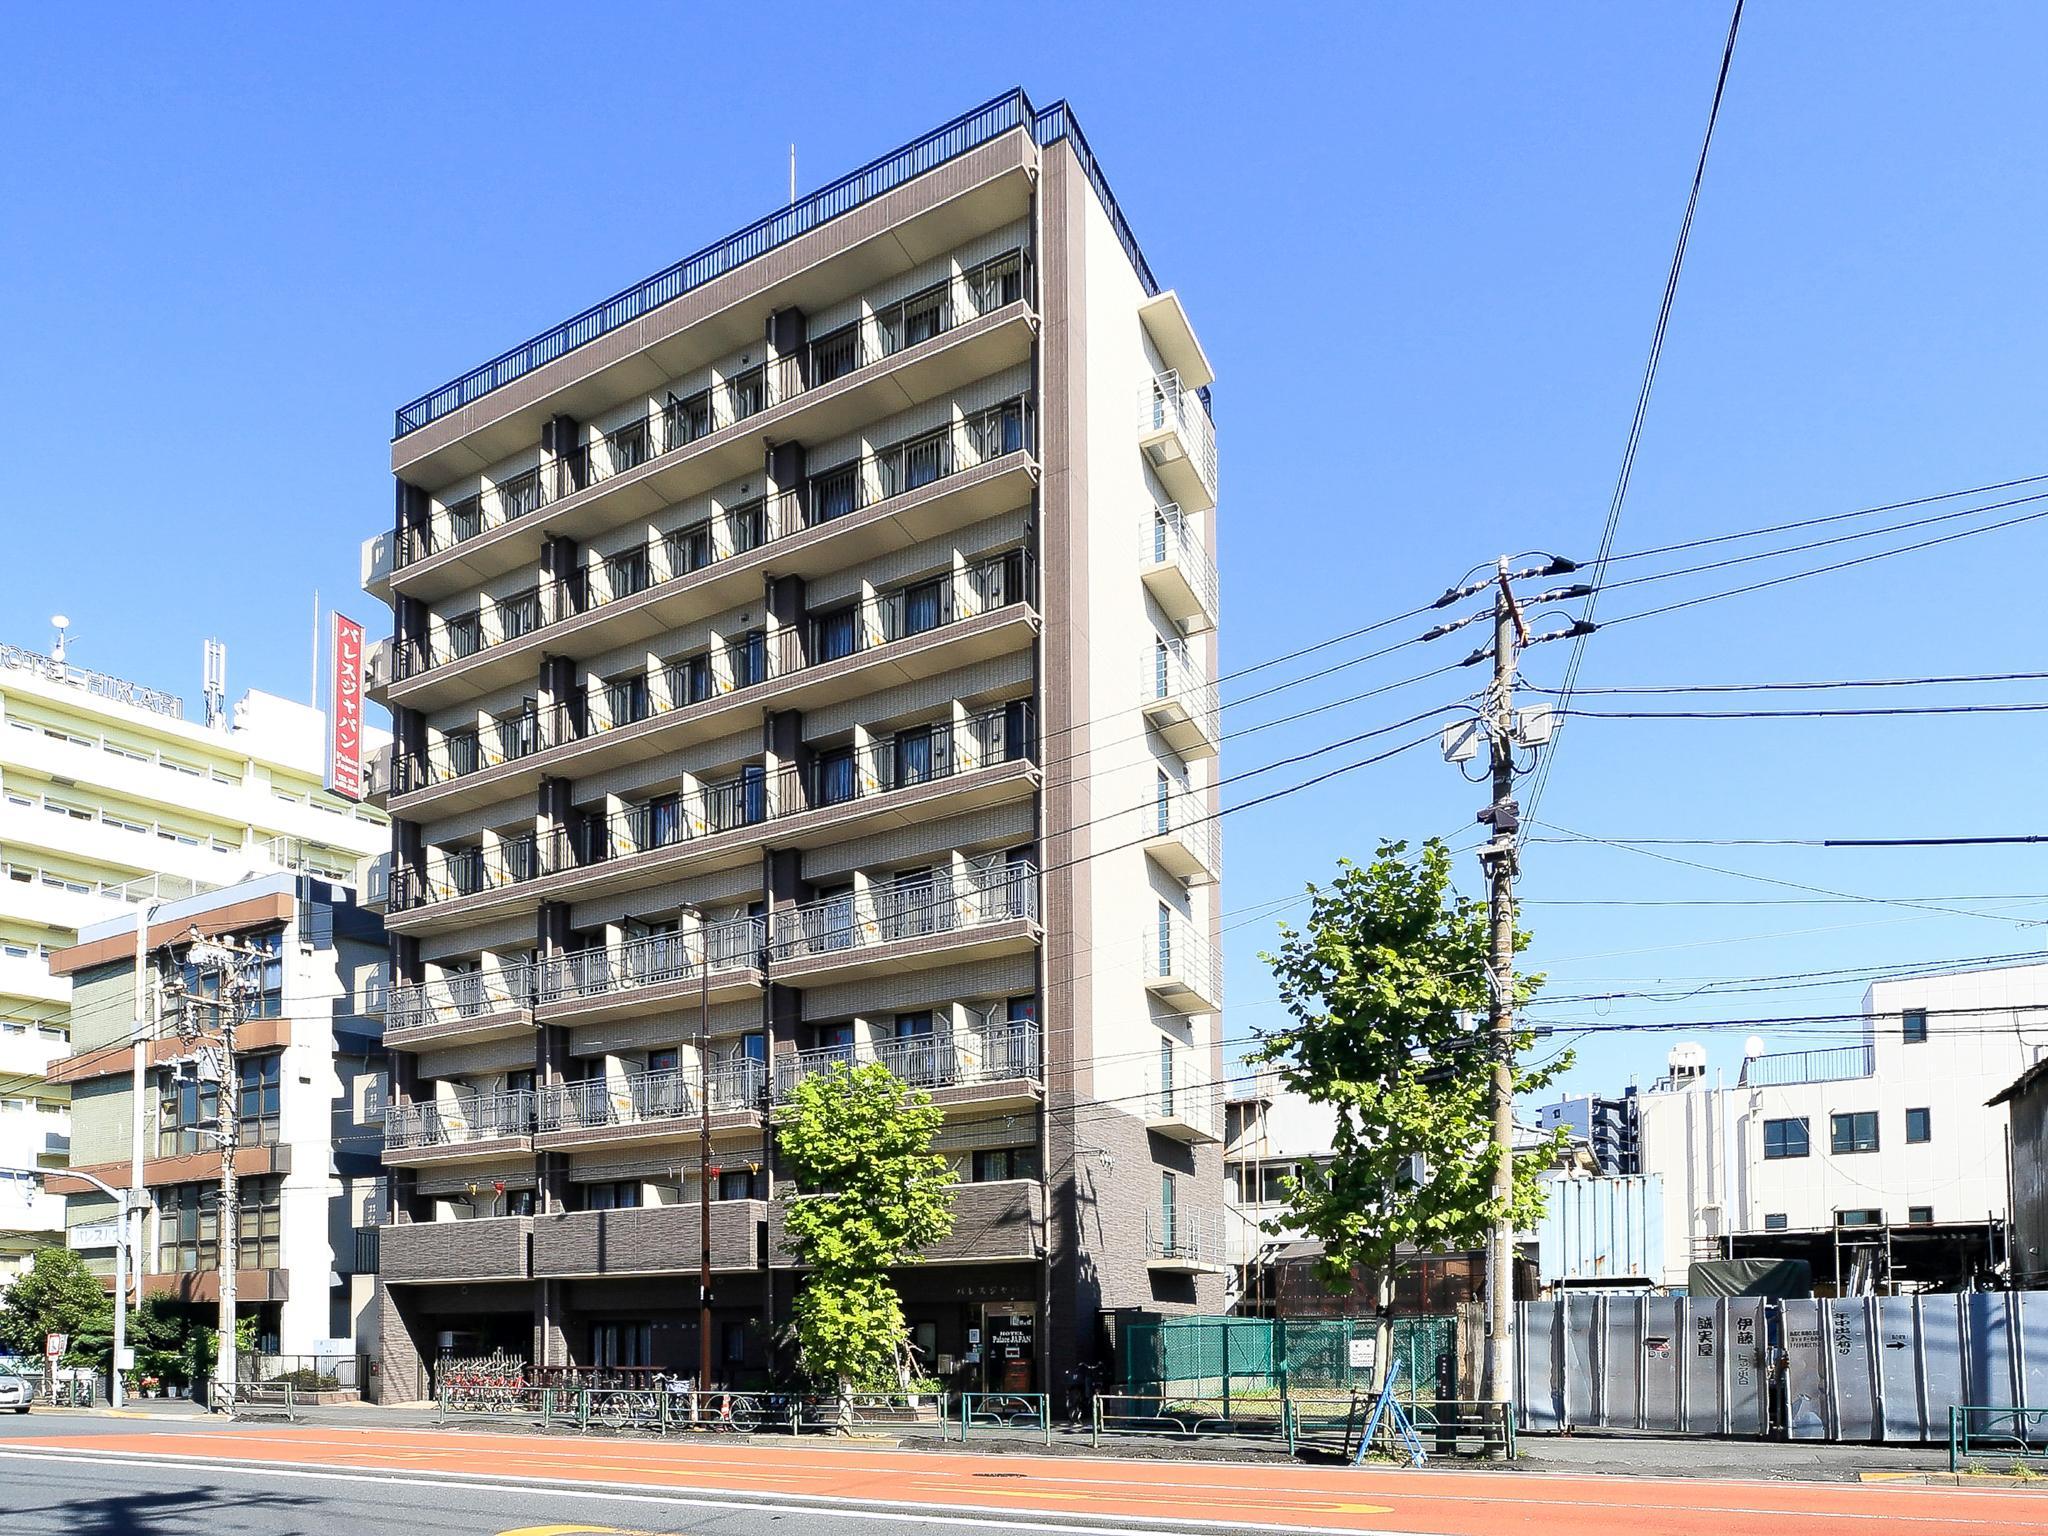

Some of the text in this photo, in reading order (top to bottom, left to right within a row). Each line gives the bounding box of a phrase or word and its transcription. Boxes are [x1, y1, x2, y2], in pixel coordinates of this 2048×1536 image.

[86, 668, 184, 720] HIKARI
[339, 627, 360, 749] パレスジャパン
[1737, 1317, 1753, 1344] 伊藤
